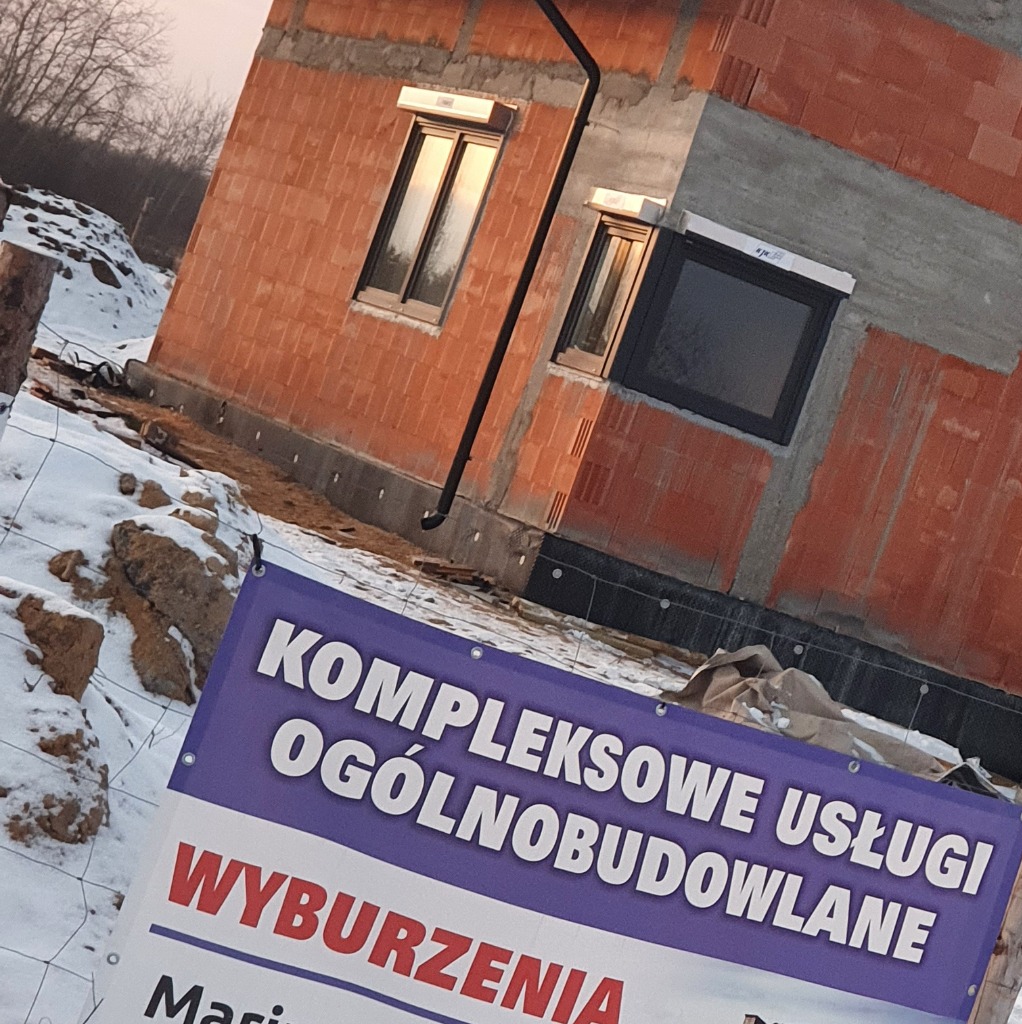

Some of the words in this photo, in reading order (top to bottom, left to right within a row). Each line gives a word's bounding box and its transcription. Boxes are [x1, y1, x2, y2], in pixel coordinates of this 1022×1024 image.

[257, 618, 764, 833] KOMPLEKSOWE
[775, 787, 994, 895] USŁUGI
[270, 718, 937, 964] OGÓLNOBUDOWLANE
